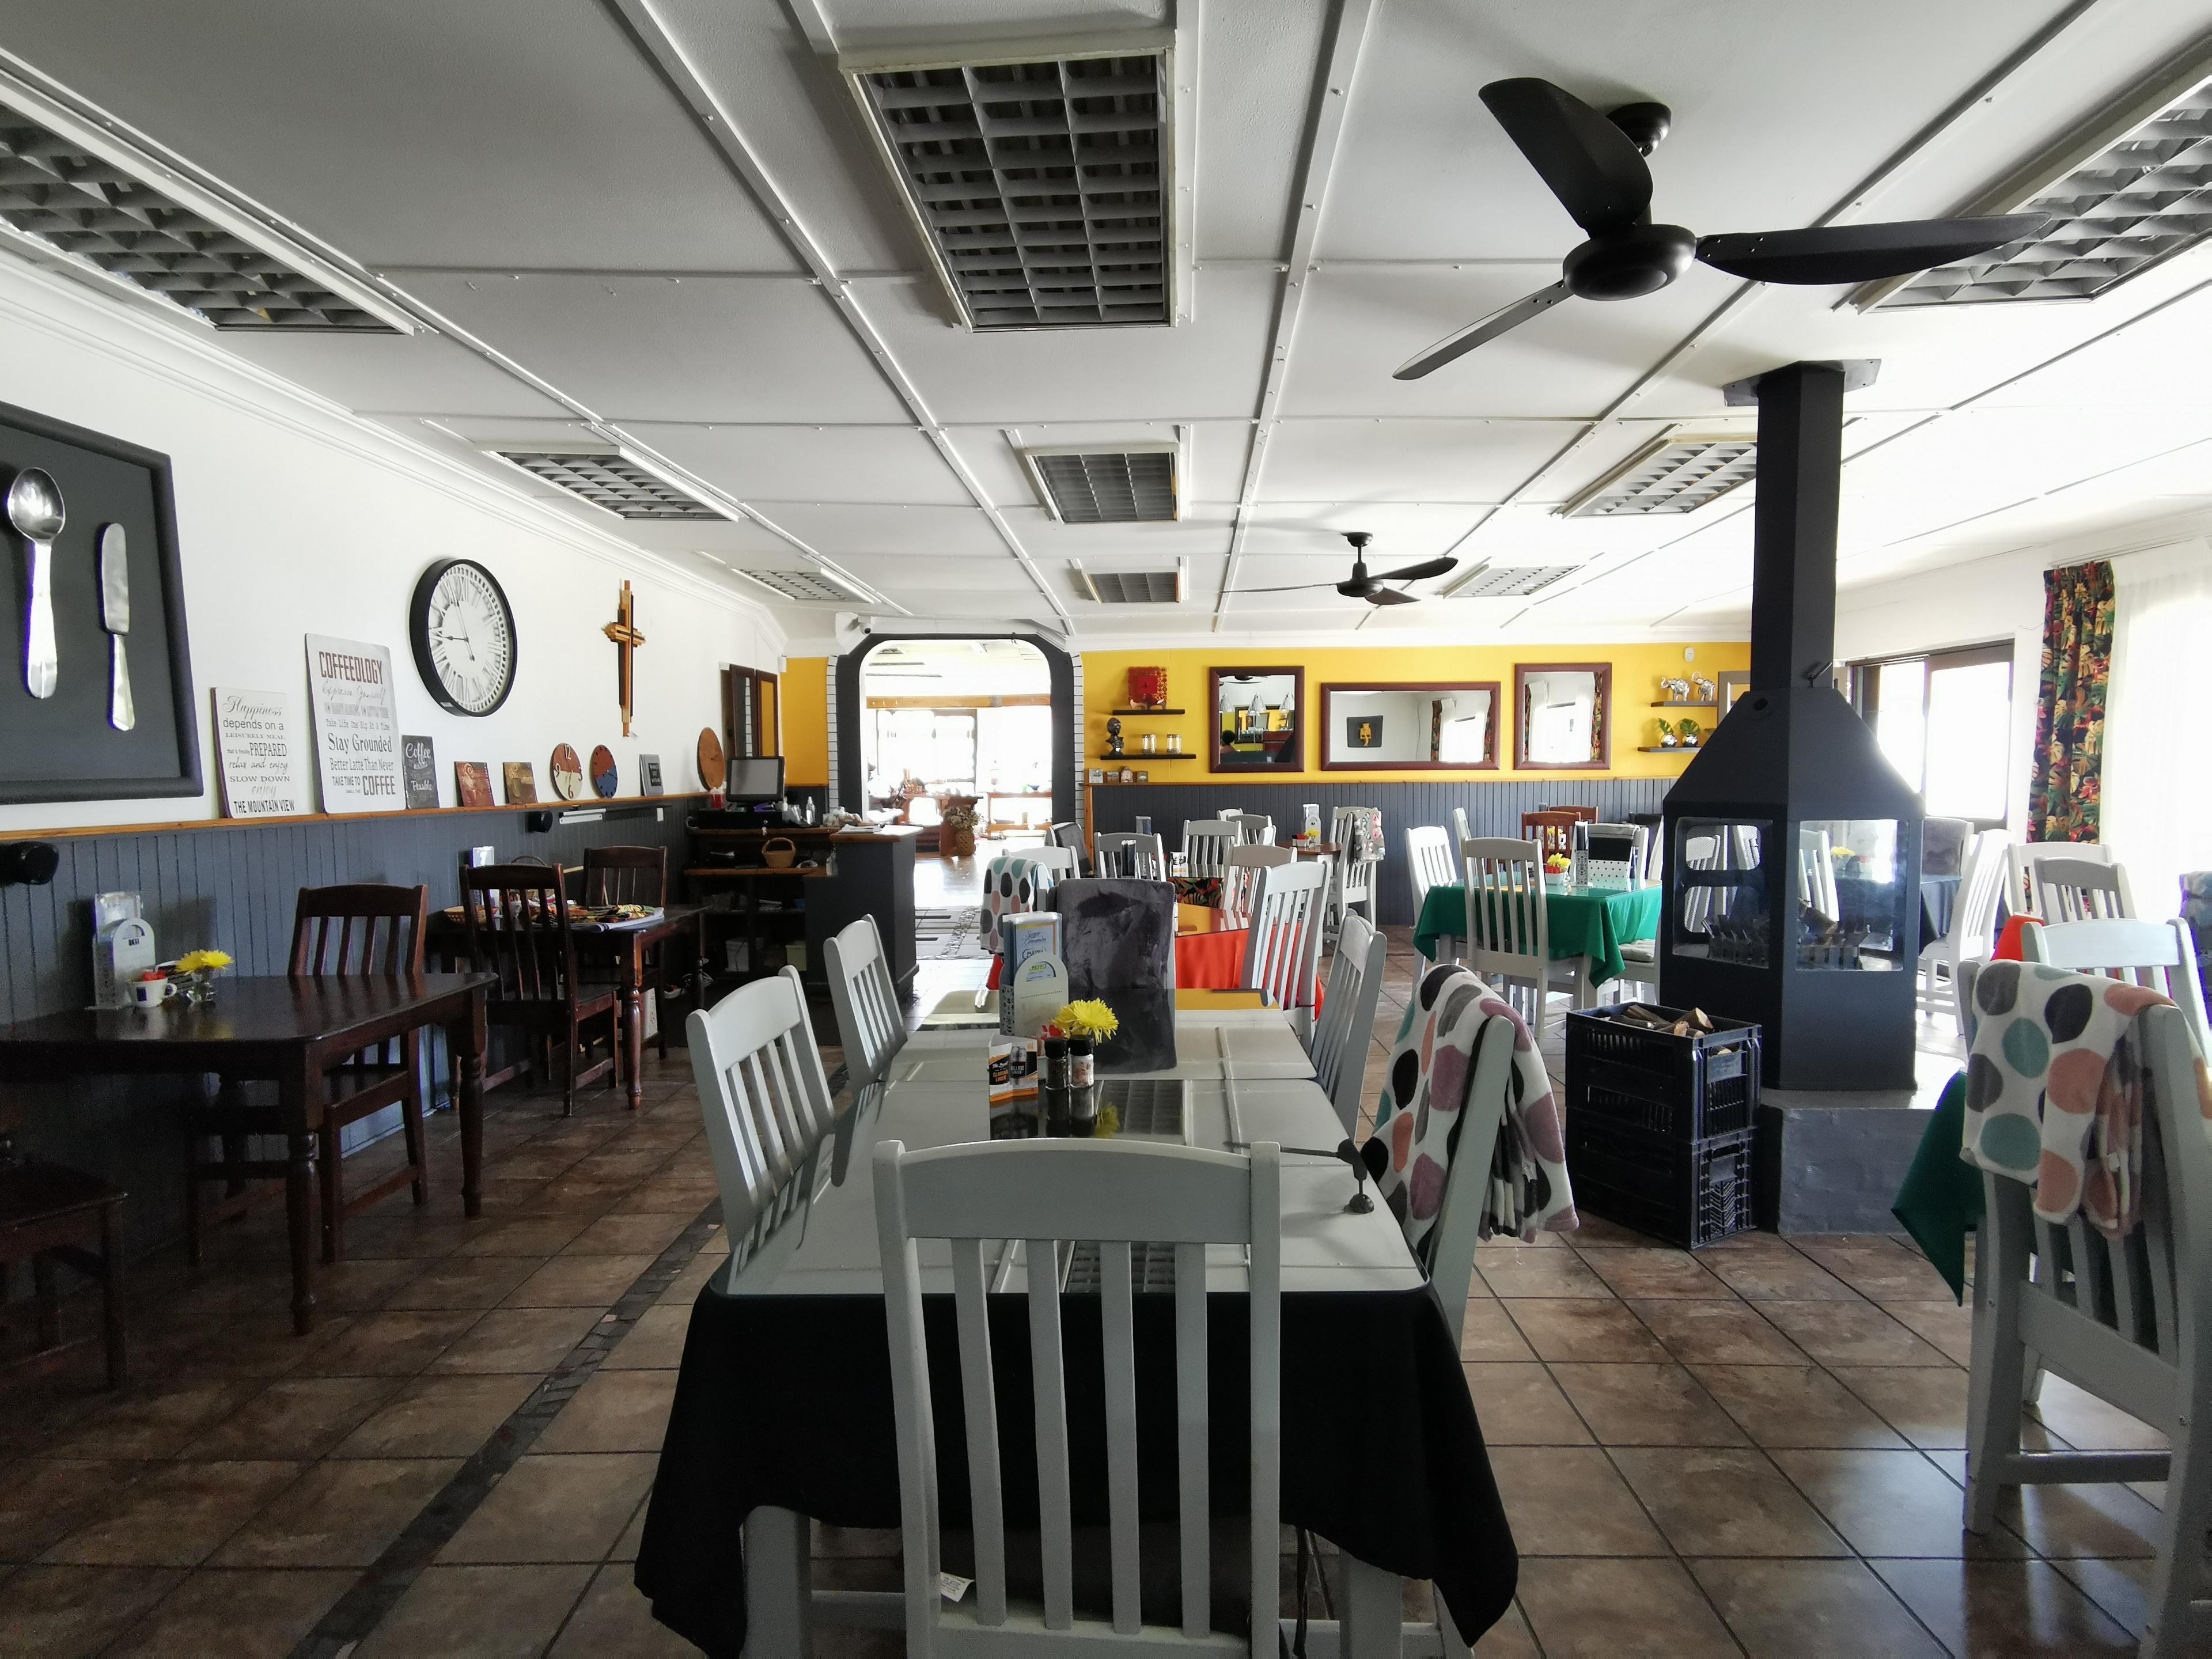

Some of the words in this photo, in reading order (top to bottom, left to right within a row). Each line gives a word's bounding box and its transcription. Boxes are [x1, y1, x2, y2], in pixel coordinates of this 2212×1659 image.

[319, 651, 382, 684] COFFEEOLOGY
[222, 695, 282, 720] Happiness
[223, 718, 262, 730] depends
[249, 743, 287, 756] PREPARED
[328, 732, 349, 754] Stay
[352, 733, 392, 752] Grounded
[406, 741, 431, 766] Coffee
[563, 744, 572, 760] 12
[229, 756, 247, 769] relax
[251, 757, 266, 768] and
[269, 762, 288, 775] enjoy
[329, 757, 348, 771] Better
[349, 757, 364, 771] Latte
[363, 758, 378, 771] Than
[378, 759, 393, 771] Never
[555, 763, 561, 778] 9
[578, 766, 583, 781] 3
[251, 783, 276, 798] enjoy
[332, 776, 344, 786] TAKE
[344, 776, 354, 786] TIME
[354, 776, 361, 786] TO
[362, 775, 396, 796] COFFEE
[568, 785, 574, 799] 6
[234, 801, 247, 813] THE
[247, 800, 279, 813] MOUNTAIN
[279, 799, 294, 812] VIEW
